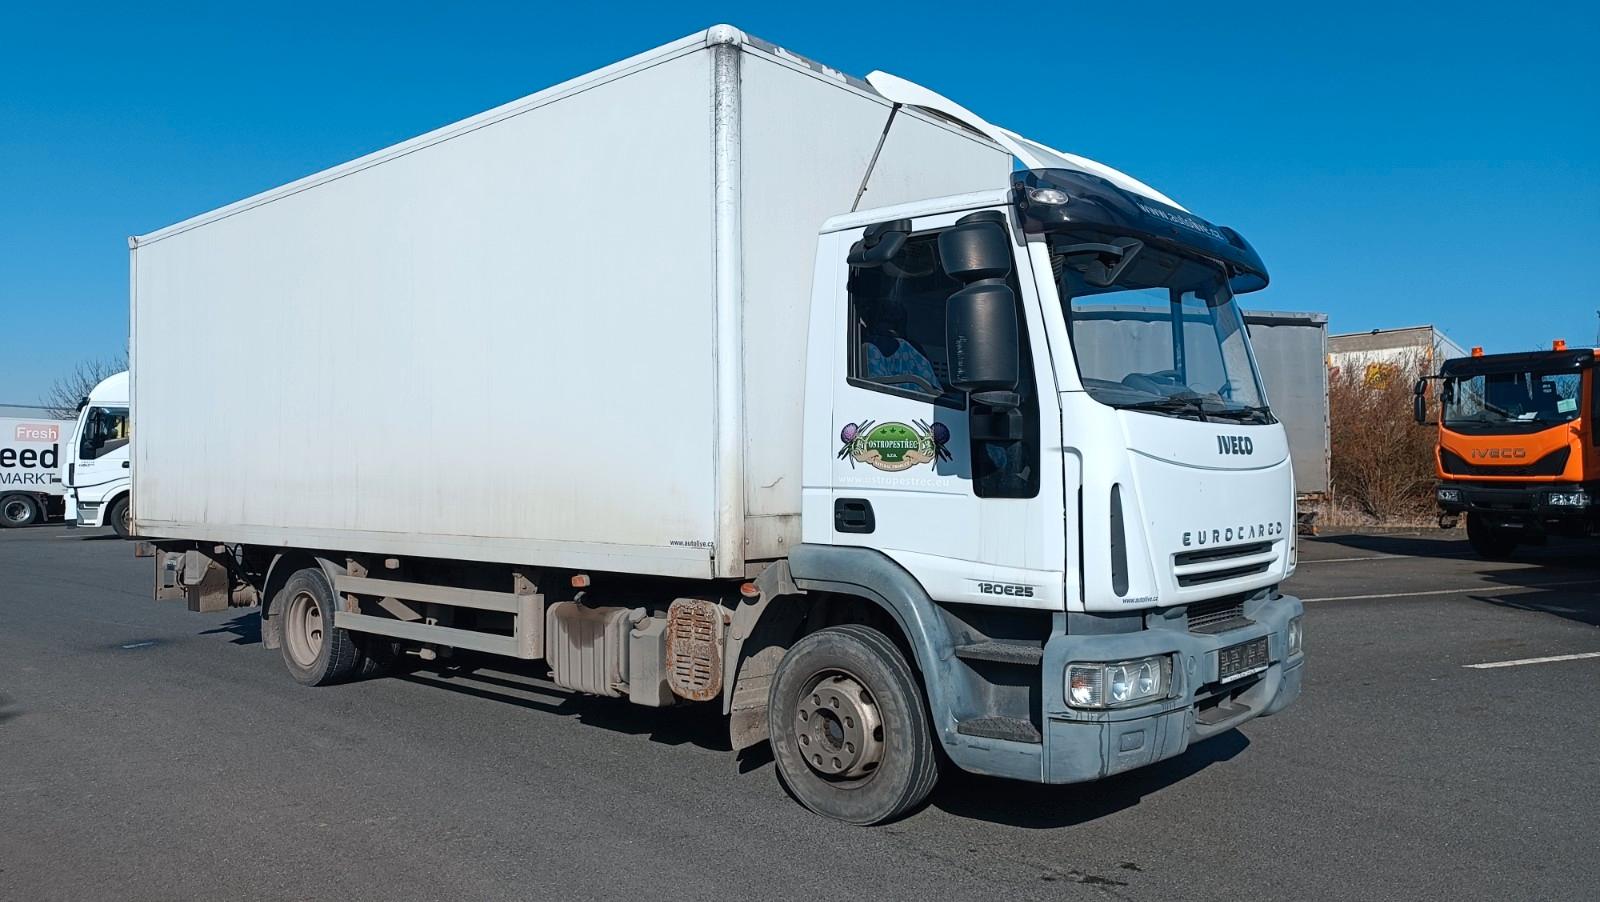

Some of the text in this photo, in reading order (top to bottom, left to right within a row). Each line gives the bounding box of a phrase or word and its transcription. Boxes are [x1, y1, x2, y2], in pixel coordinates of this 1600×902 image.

[16, 426, 57, 439] Fresh
[1217, 435, 1253, 455] IVECO
[1471, 448, 1526, 459] IVECO
[0, 443, 58, 468] eed
[1182, 521, 1282, 546] EUROCARGO
[977, 582, 1034, 598] 120E25
